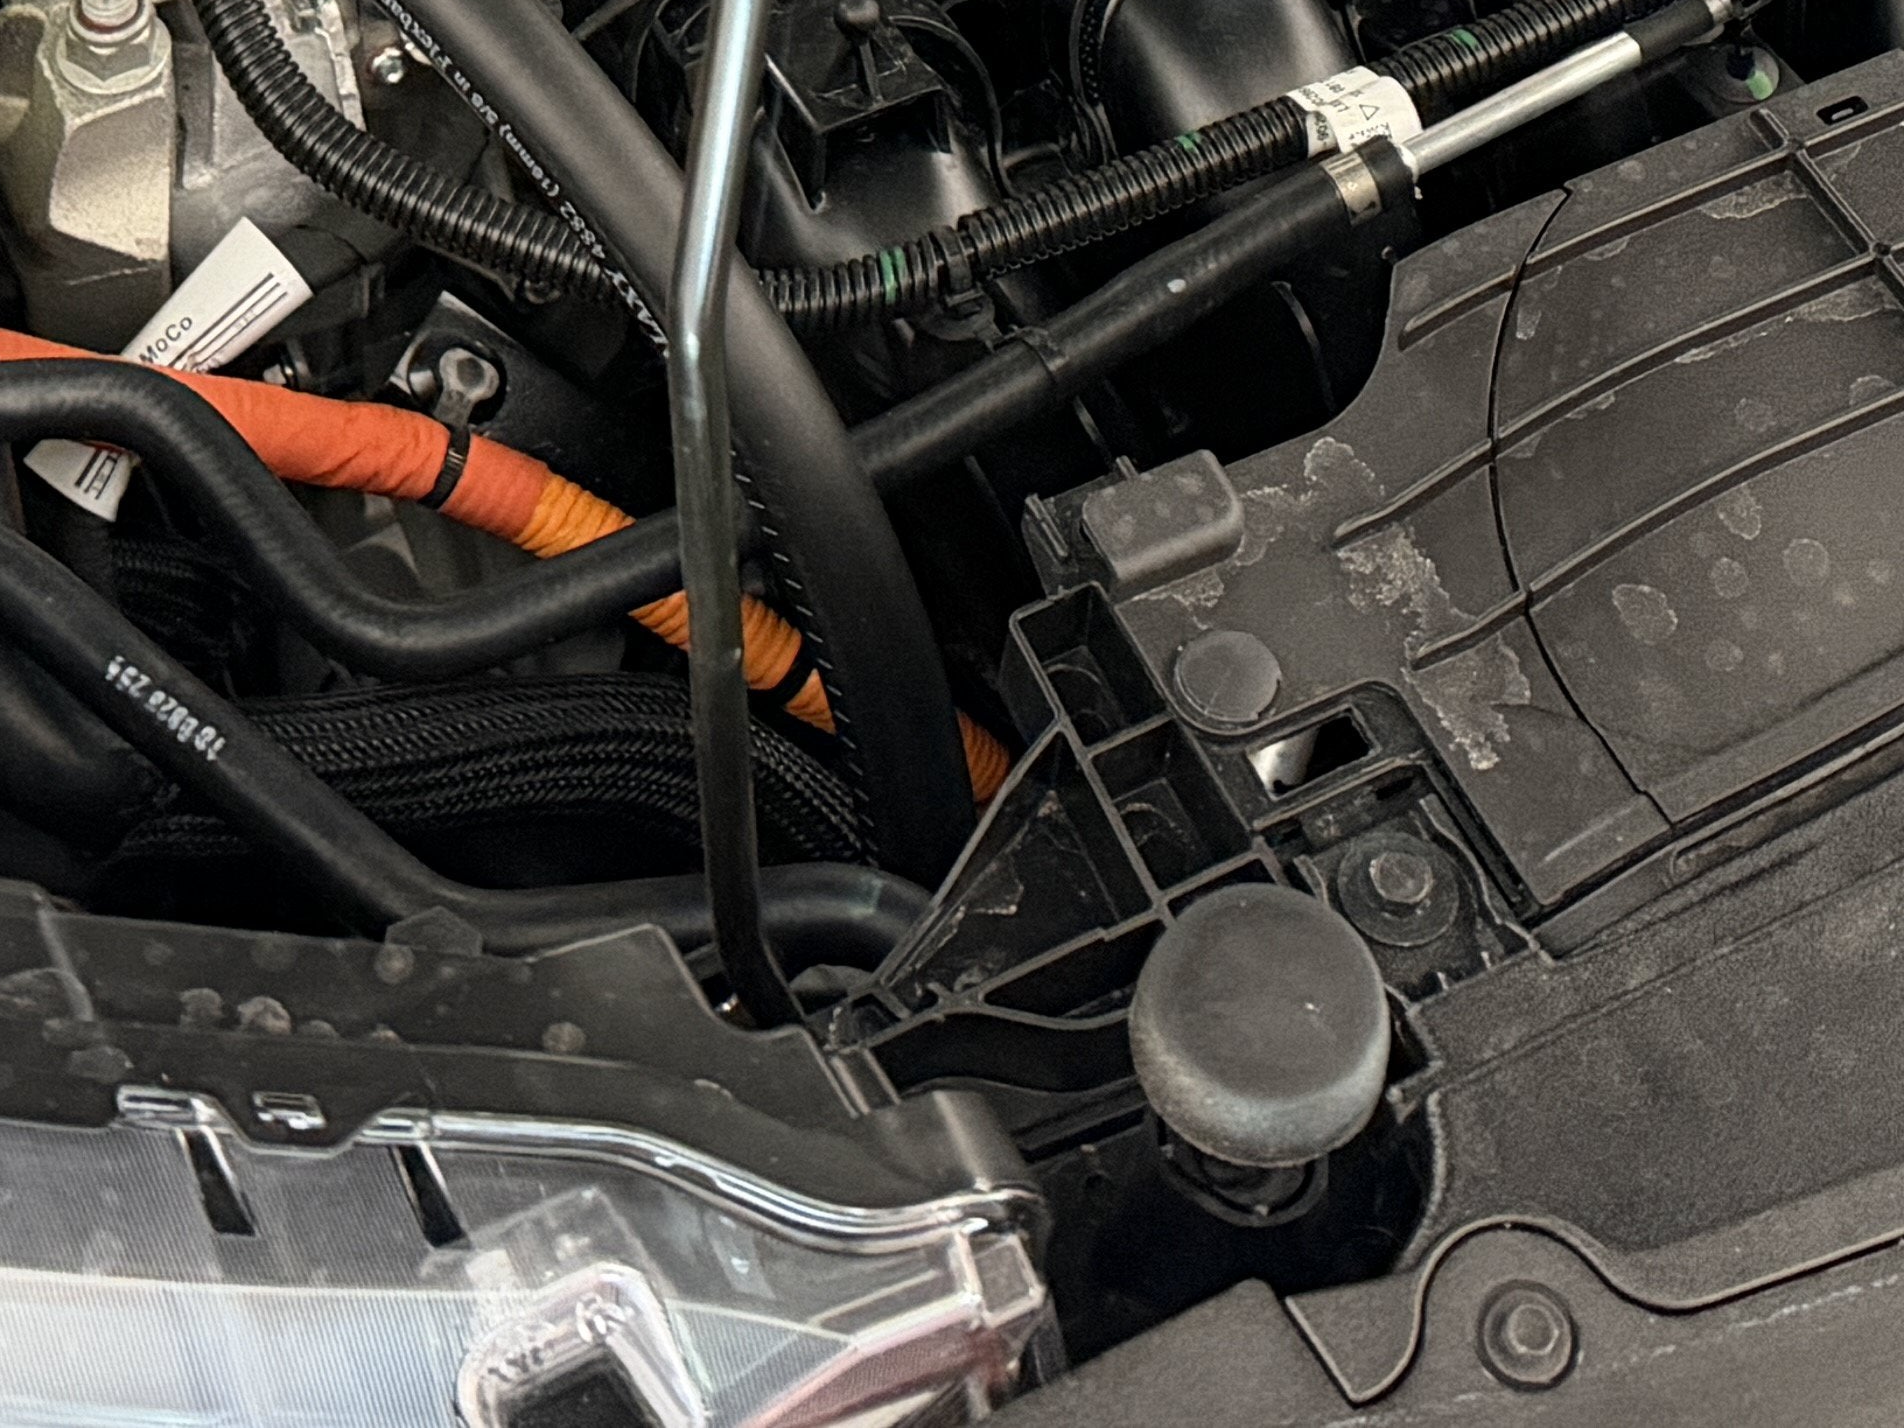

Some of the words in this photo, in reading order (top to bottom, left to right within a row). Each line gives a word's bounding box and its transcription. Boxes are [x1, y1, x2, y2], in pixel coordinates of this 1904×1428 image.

[455, 72, 470, 90] in
[560, 202, 605, 258] 4882
[138, 317, 193, 364] MoCo
